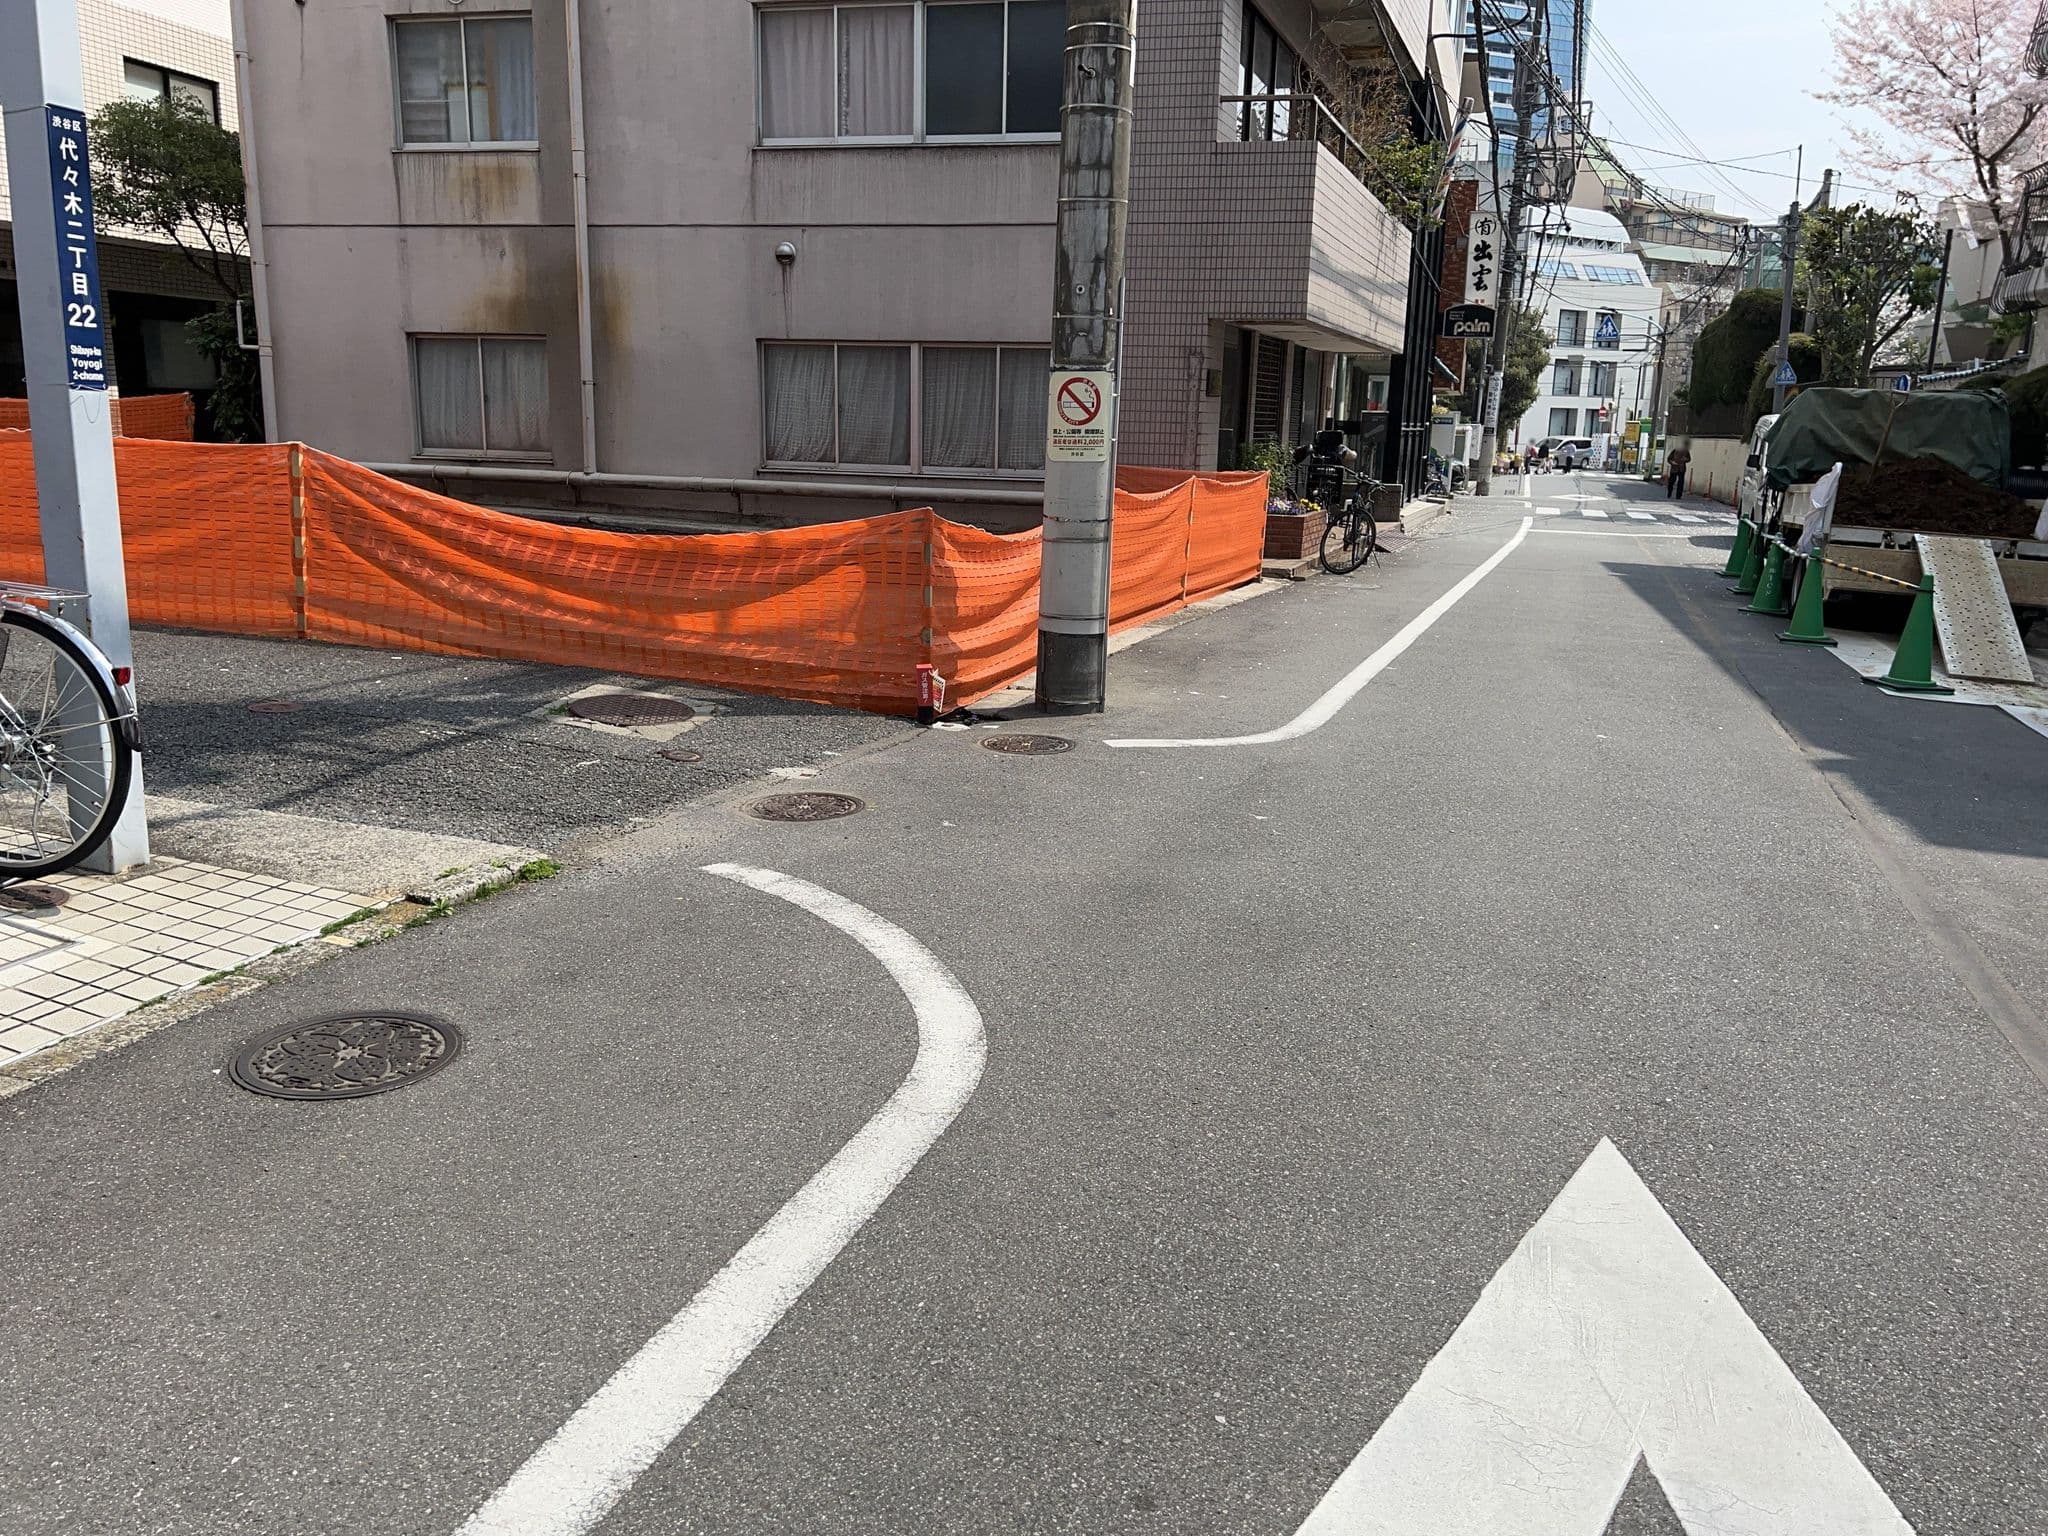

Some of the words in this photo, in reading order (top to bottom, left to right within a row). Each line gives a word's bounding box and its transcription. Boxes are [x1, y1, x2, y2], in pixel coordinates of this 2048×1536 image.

[52, 115, 82, 132] 渋谷区
[59, 136, 88, 296] 代々木二丁目
[67, 302, 98, 328] 22
[1453, 318, 1490, 335] palm
[70, 345, 102, 357] Shibuya-ku
[71, 358, 103, 370] Yoyogi
[72, 370, 104, 381] 2-chome
